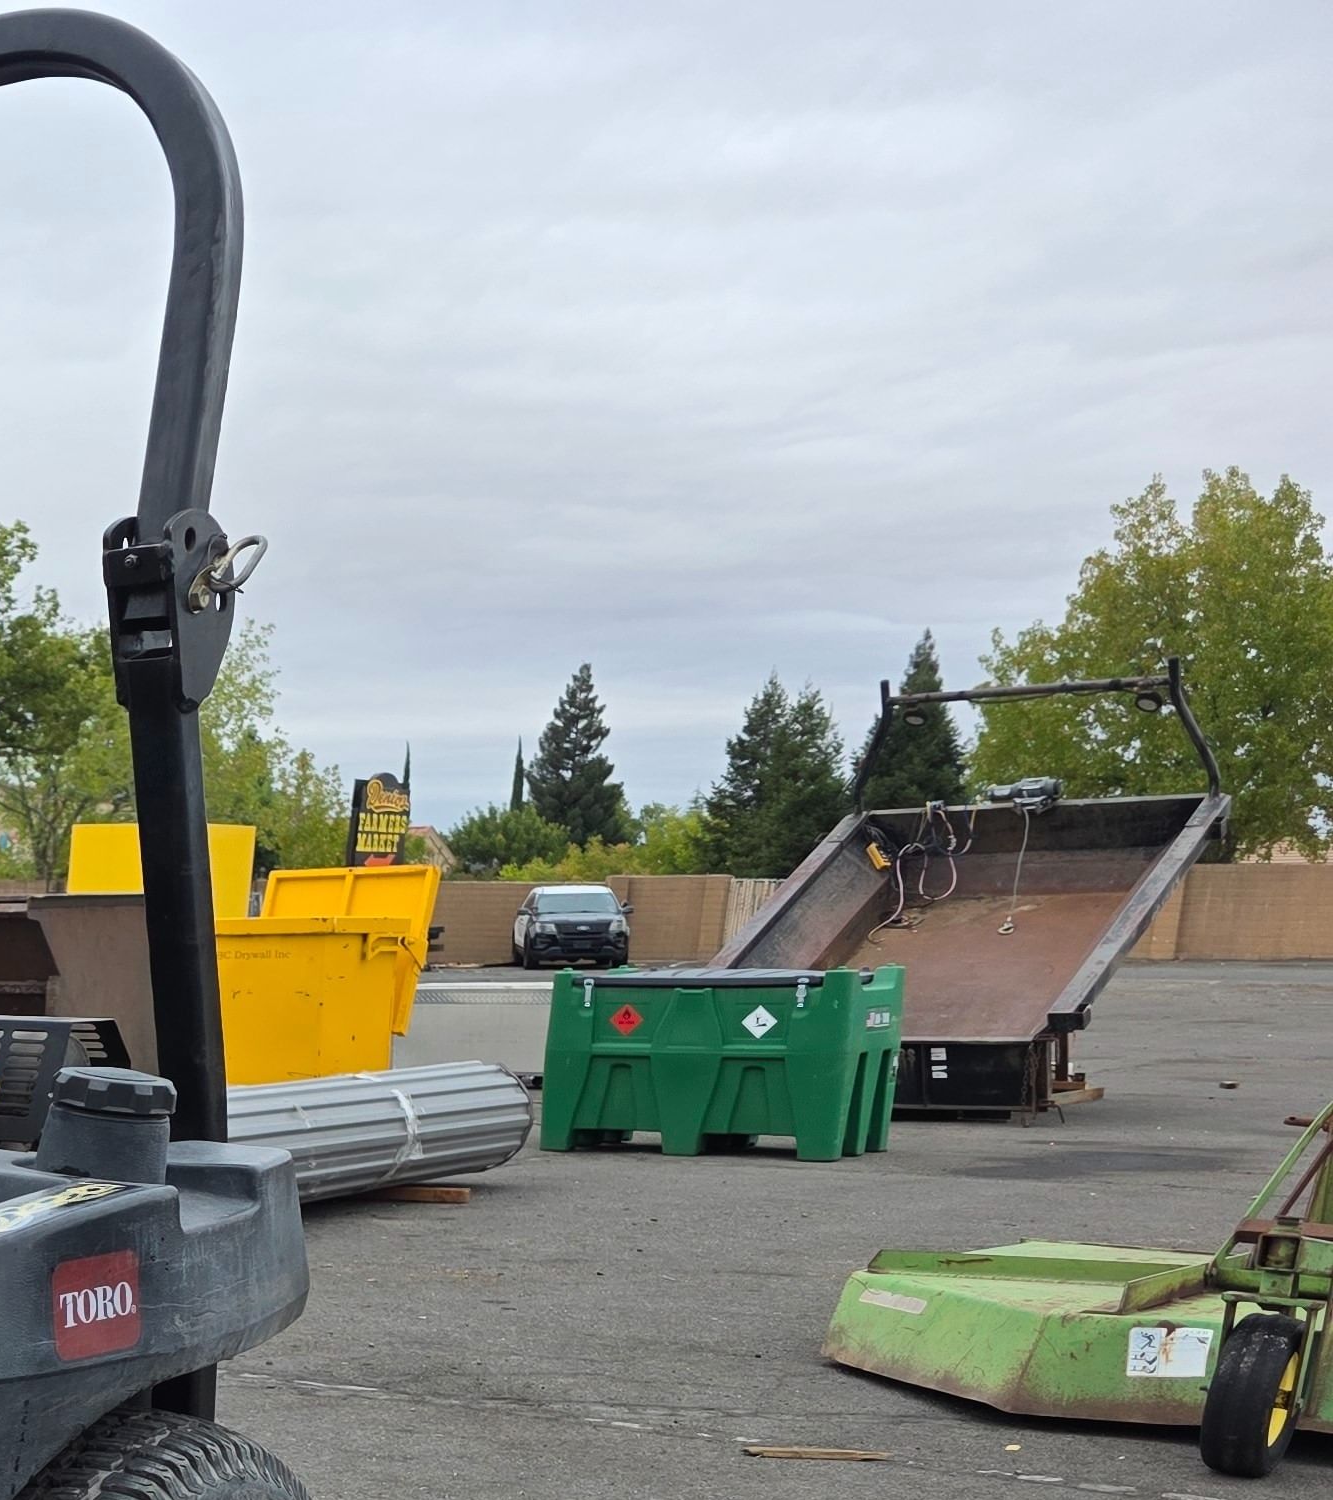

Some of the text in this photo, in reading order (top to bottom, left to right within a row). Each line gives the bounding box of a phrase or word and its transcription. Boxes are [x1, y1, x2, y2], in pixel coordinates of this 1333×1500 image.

[358, 812, 408, 834] FARMERS
[355, 832, 400, 853] MARKET
[234, 950, 272, 961] Drywall
[59, 1281, 134, 1329] TORO
